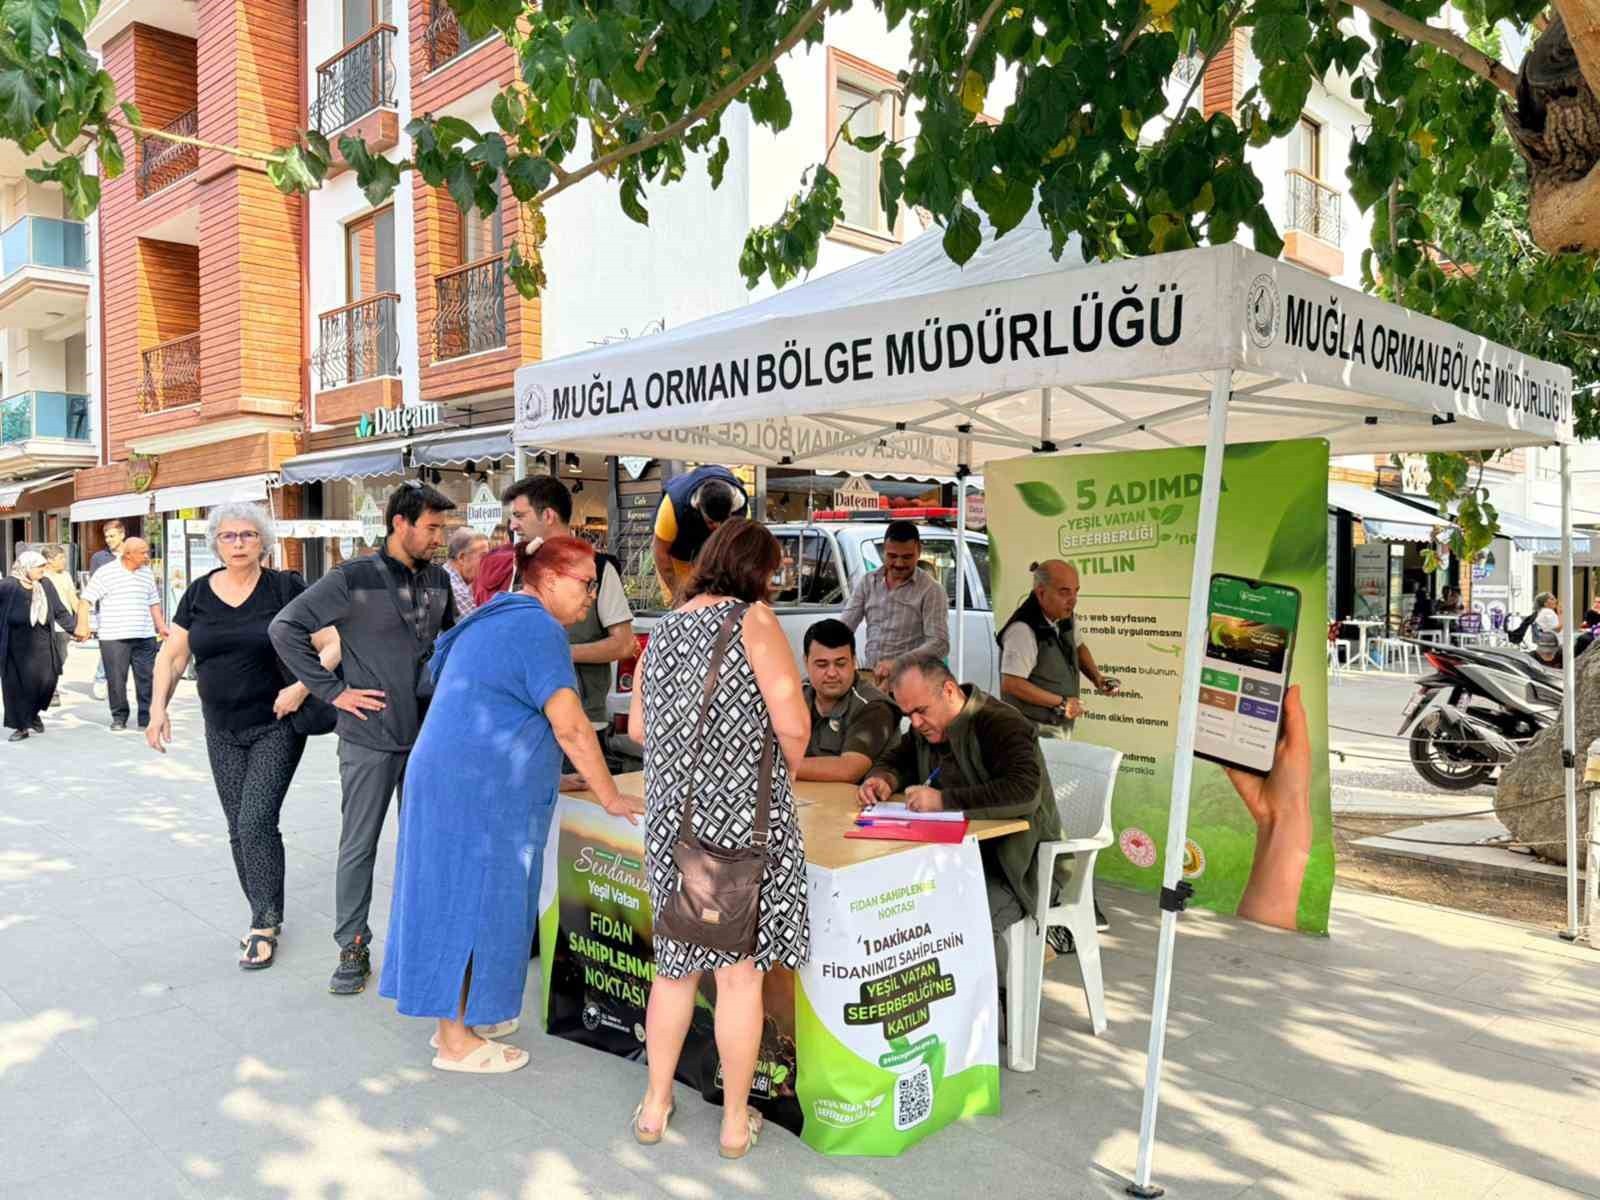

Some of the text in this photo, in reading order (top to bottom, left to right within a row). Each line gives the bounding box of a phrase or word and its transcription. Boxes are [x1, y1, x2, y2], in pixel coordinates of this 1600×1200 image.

[551, 371, 639, 421] MUĞLA
[645, 358, 750, 409] ORMAN
[756, 338, 874, 393] BÖLGE
[886, 282, 1184, 377] MÜDÜRLÜĞÜ
[1285, 294, 1366, 365] MUĞLA
[1371, 324, 1439, 385] ORMAN
[1439, 341, 1491, 400] BÖLGE
[1493, 363, 1568, 424] MÜDÜRLÜĞÜ
[374, 401, 439, 437] Datçam
[1076, 479, 1097, 511] 5
[1067, 509, 1146, 531] YEŞİL VATAN
[588, 879, 640, 911] Yeşil Vatan
[822, 931, 964, 980] FİDANINIZI SAHİPLENİN
[873, 922, 932, 953] DAKİKADA
[585, 965, 646, 1008] NOKTASI
[866, 961, 937, 998] YEŞİL VATAN
[847, 978, 954, 1021] SEFERBERLİĞİ'NE
[887, 1007, 929, 1036] KATILIN
